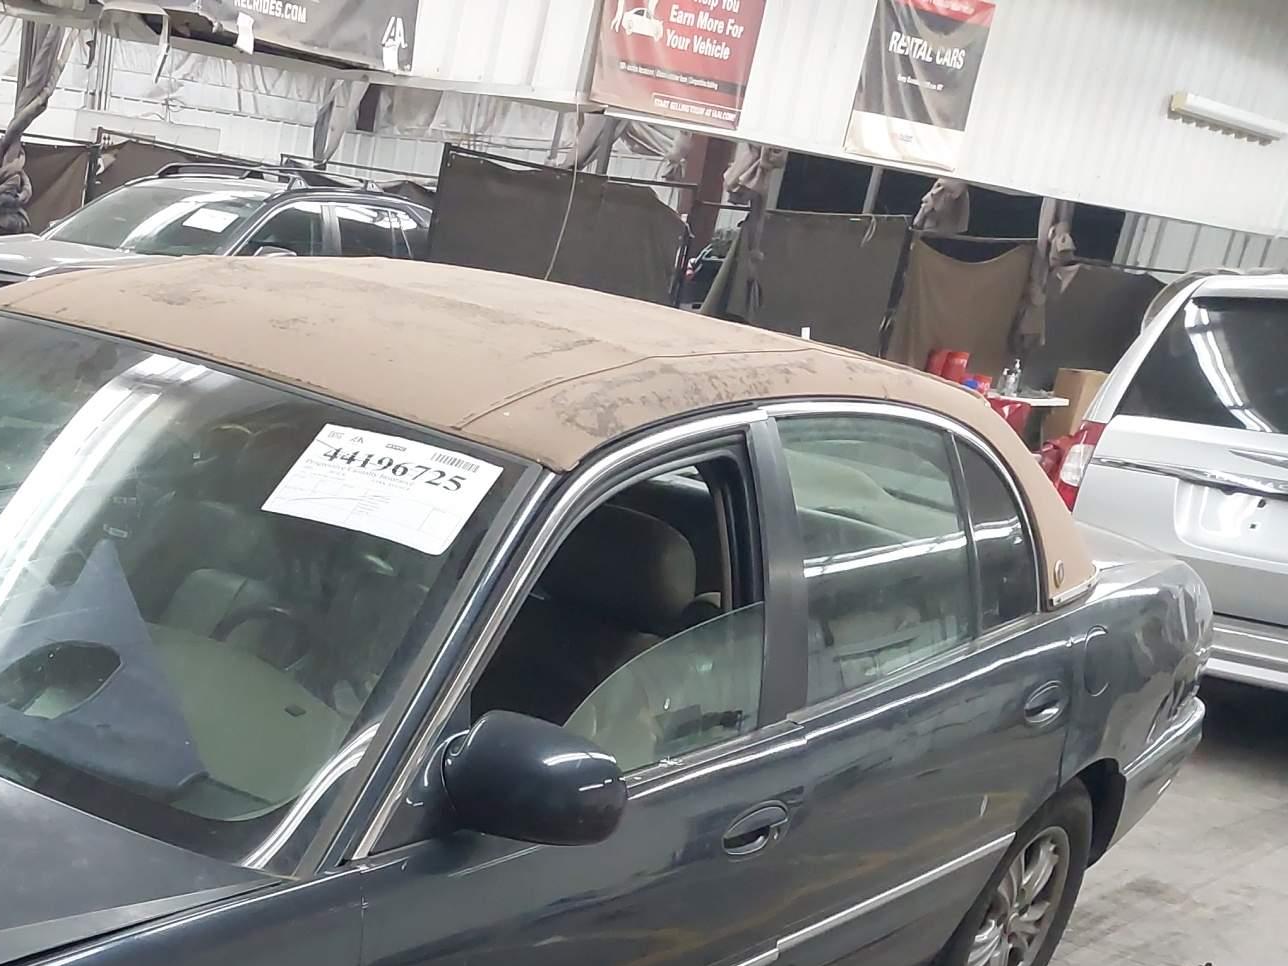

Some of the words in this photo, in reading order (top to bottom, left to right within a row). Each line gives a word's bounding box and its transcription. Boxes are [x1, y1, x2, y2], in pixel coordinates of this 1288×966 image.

[670, 4, 695, 27] Earn
[697, 11, 725, 34] More
[726, 18, 744, 39] For
[666, 29, 691, 51] Your
[692, 34, 730, 60] Vehicle
[888, 31, 933, 62] RENTAL
[935, 47, 966, 70] CARS
[322, 447, 467, 492] 44196725
